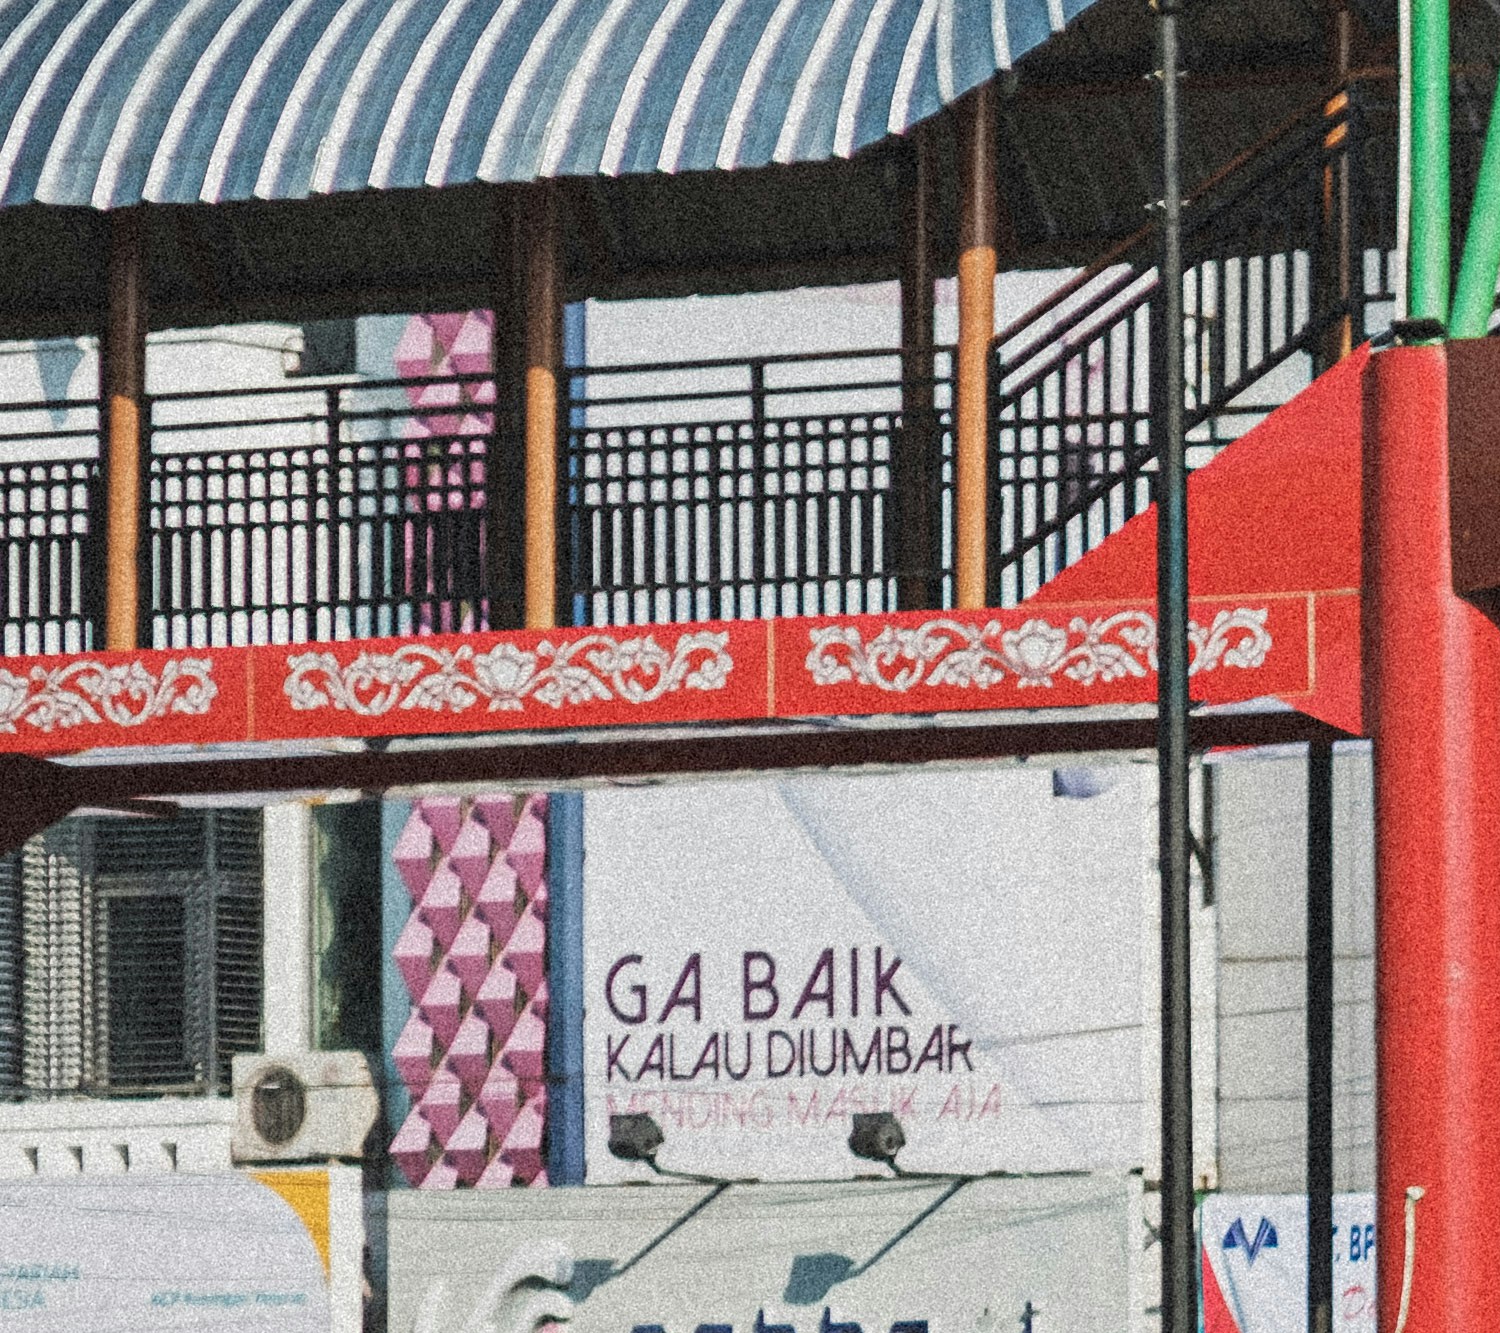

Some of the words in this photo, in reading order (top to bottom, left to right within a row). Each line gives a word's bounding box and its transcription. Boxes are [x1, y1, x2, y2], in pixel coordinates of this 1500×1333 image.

[605, 953, 702, 1024] GA
[743, 946, 912, 1022] BAIK
[606, 1031, 752, 1082] KALAU
[939, 1083, 1001, 1122] AJA
